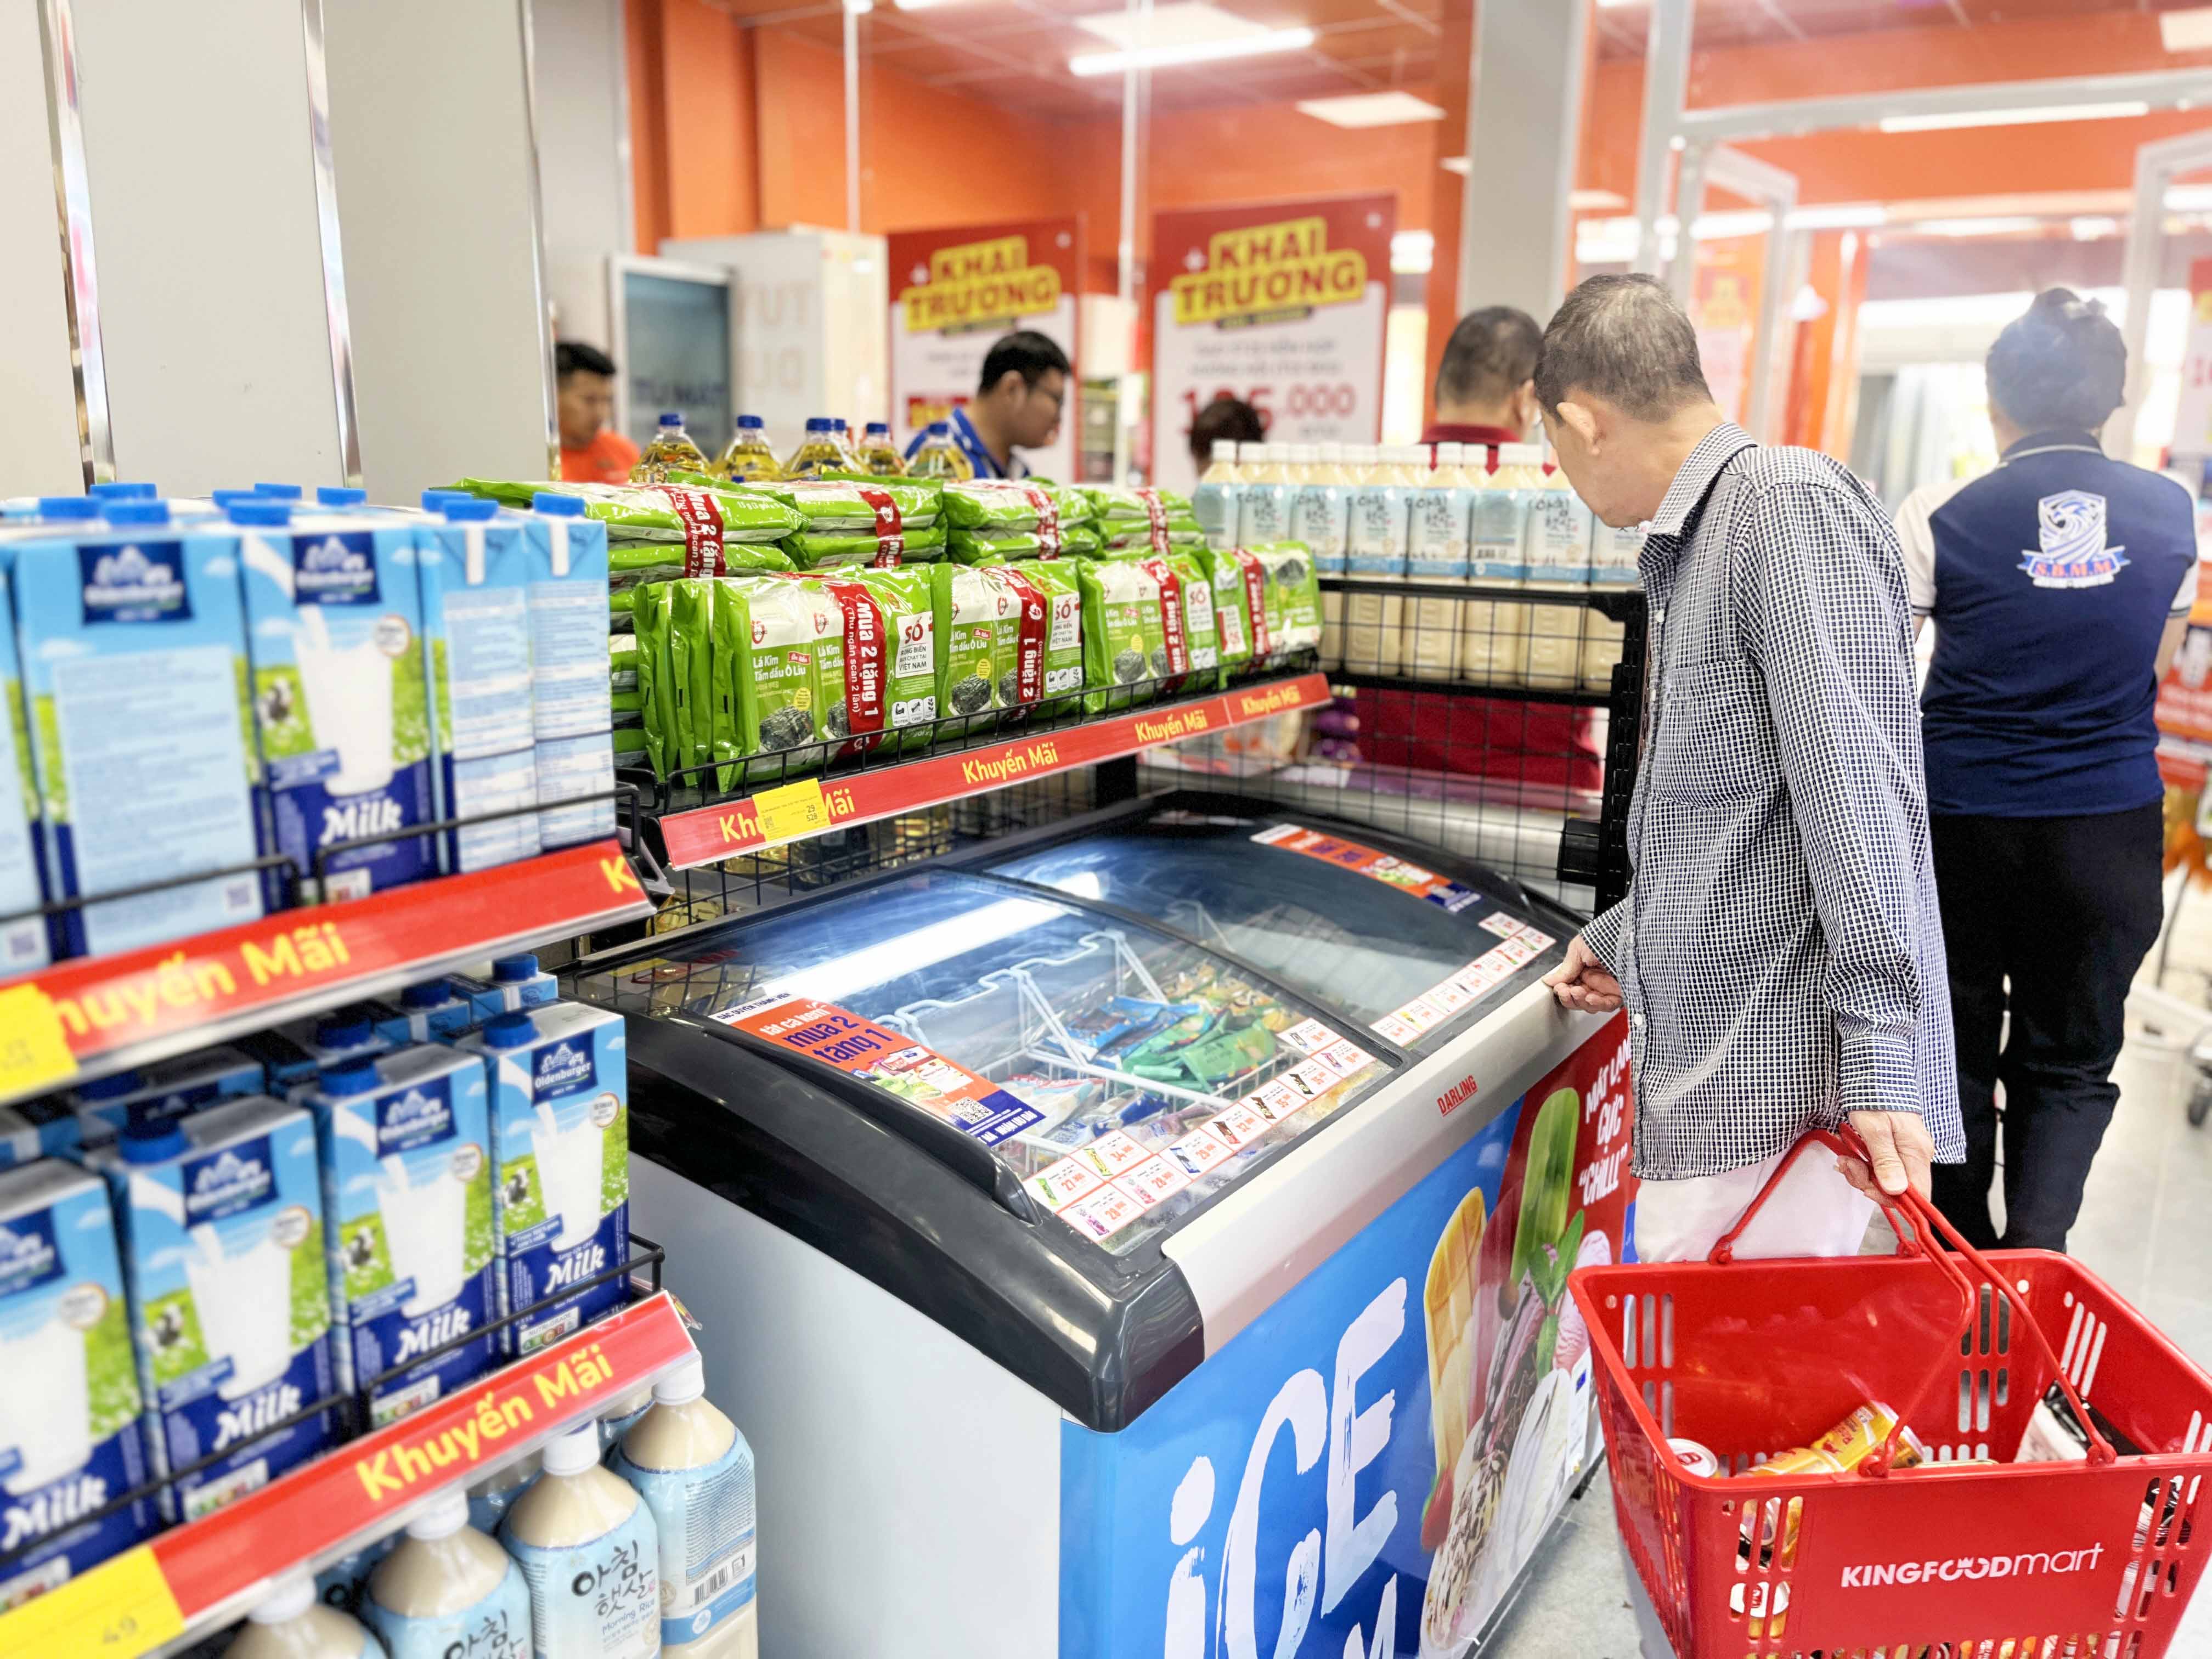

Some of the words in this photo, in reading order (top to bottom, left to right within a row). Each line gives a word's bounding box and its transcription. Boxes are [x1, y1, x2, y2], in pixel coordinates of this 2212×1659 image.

[856, 601, 874, 642] Mua
[826, 644, 840, 656] Kim
[847, 631, 856, 657] ngân
[861, 646, 878, 658] 2
[1024, 637, 1036, 646] 1
[753, 656, 764, 668] Lá
[764, 654, 779, 667] Kim
[785, 663, 793, 677] Ô
[793, 665, 806, 676] Liu
[849, 658, 859, 683] scan
[912, 660, 927, 670] NAM
[1022, 649, 1038, 685] tặng
[859, 662, 878, 702] tặng
[1023, 687, 1034, 697] 2
[864, 707, 878, 716] 1
[1135, 713, 1183, 743] Khuyến
[1184, 708, 1209, 730] Mãi
[962, 748, 1028, 785] Khuyến
[1030, 742, 1059, 771] Mãi
[319, 798, 403, 846] Milk
[240, 922, 351, 986] Mãi
[782, 1023, 843, 1048] mua
[830, 1015, 861, 1029] 2
[793, 1008, 832, 1024] kem
[812, 1034, 882, 1064] tặng
[865, 1028, 894, 1042] 1
[535, 1061, 591, 1089] Oldenburger
[1437, 1075, 1478, 1115] DARLING
[544, 1244, 605, 1295] Milk
[394, 1307, 472, 1366] Milk
[213, 1383, 302, 1451] Milk
[357, 1391, 534, 1500] Khuyến
[533, 1344, 614, 1409] Mãi
[2, 1476, 108, 1551] Milk
[571, 1538, 639, 1598] 아침
[1840, 1541, 2105, 1588] KINGFOODmart
